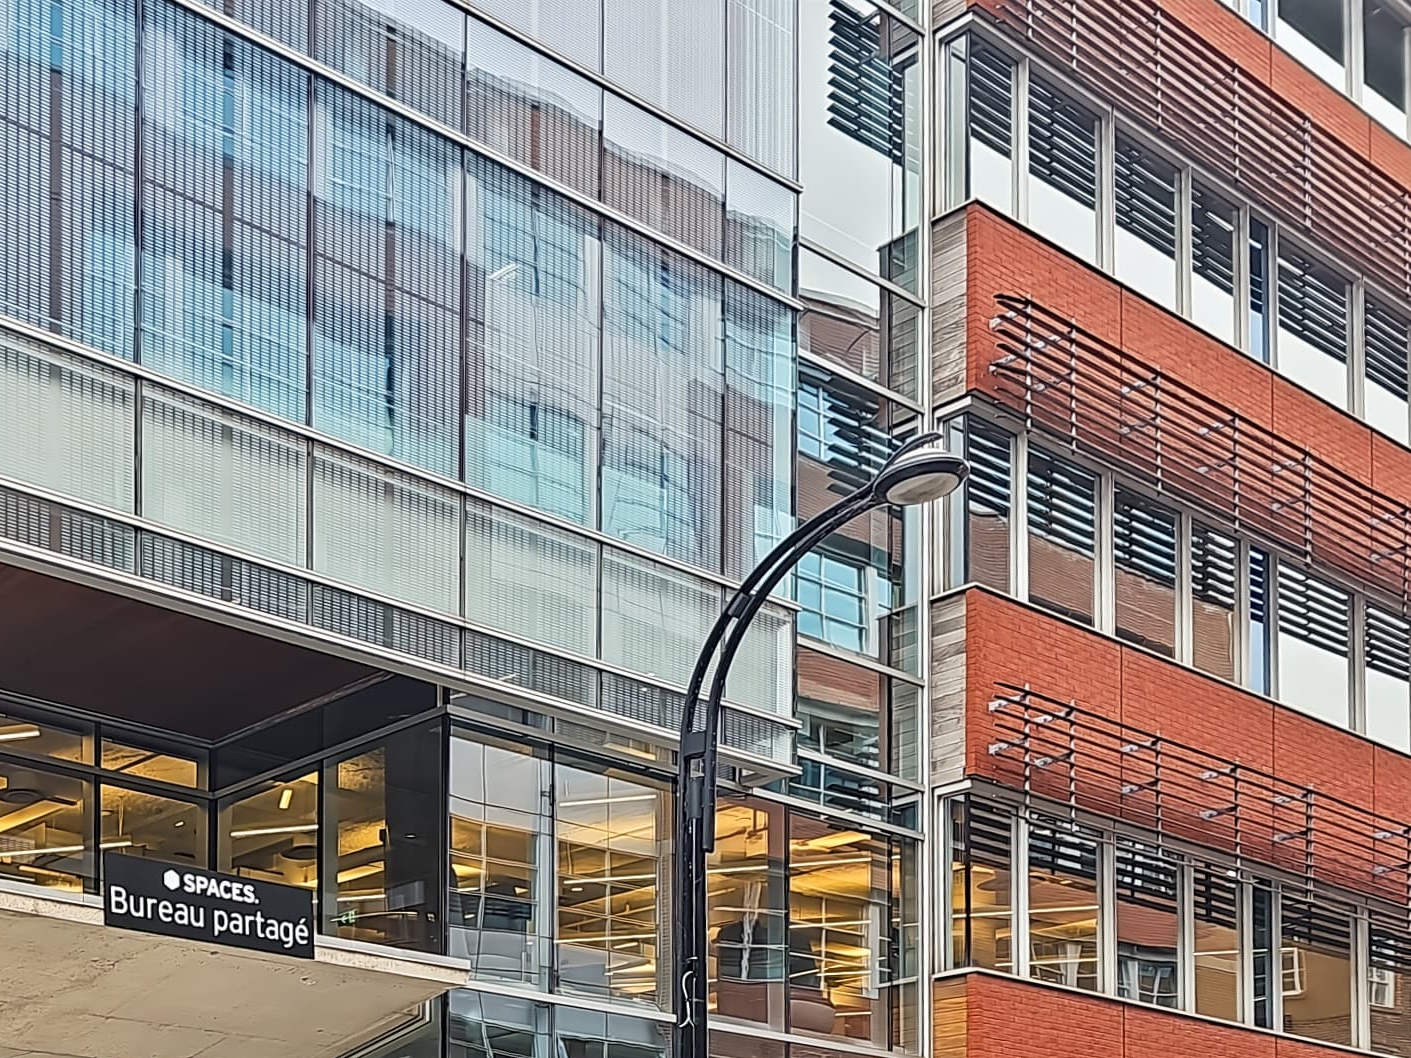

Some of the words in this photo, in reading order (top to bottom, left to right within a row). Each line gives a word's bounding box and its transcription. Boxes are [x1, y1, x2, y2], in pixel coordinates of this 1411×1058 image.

[183, 873, 260, 904] SPACES.
[110, 886, 205, 928] Bureau
[213, 910, 310, 949] partagé
